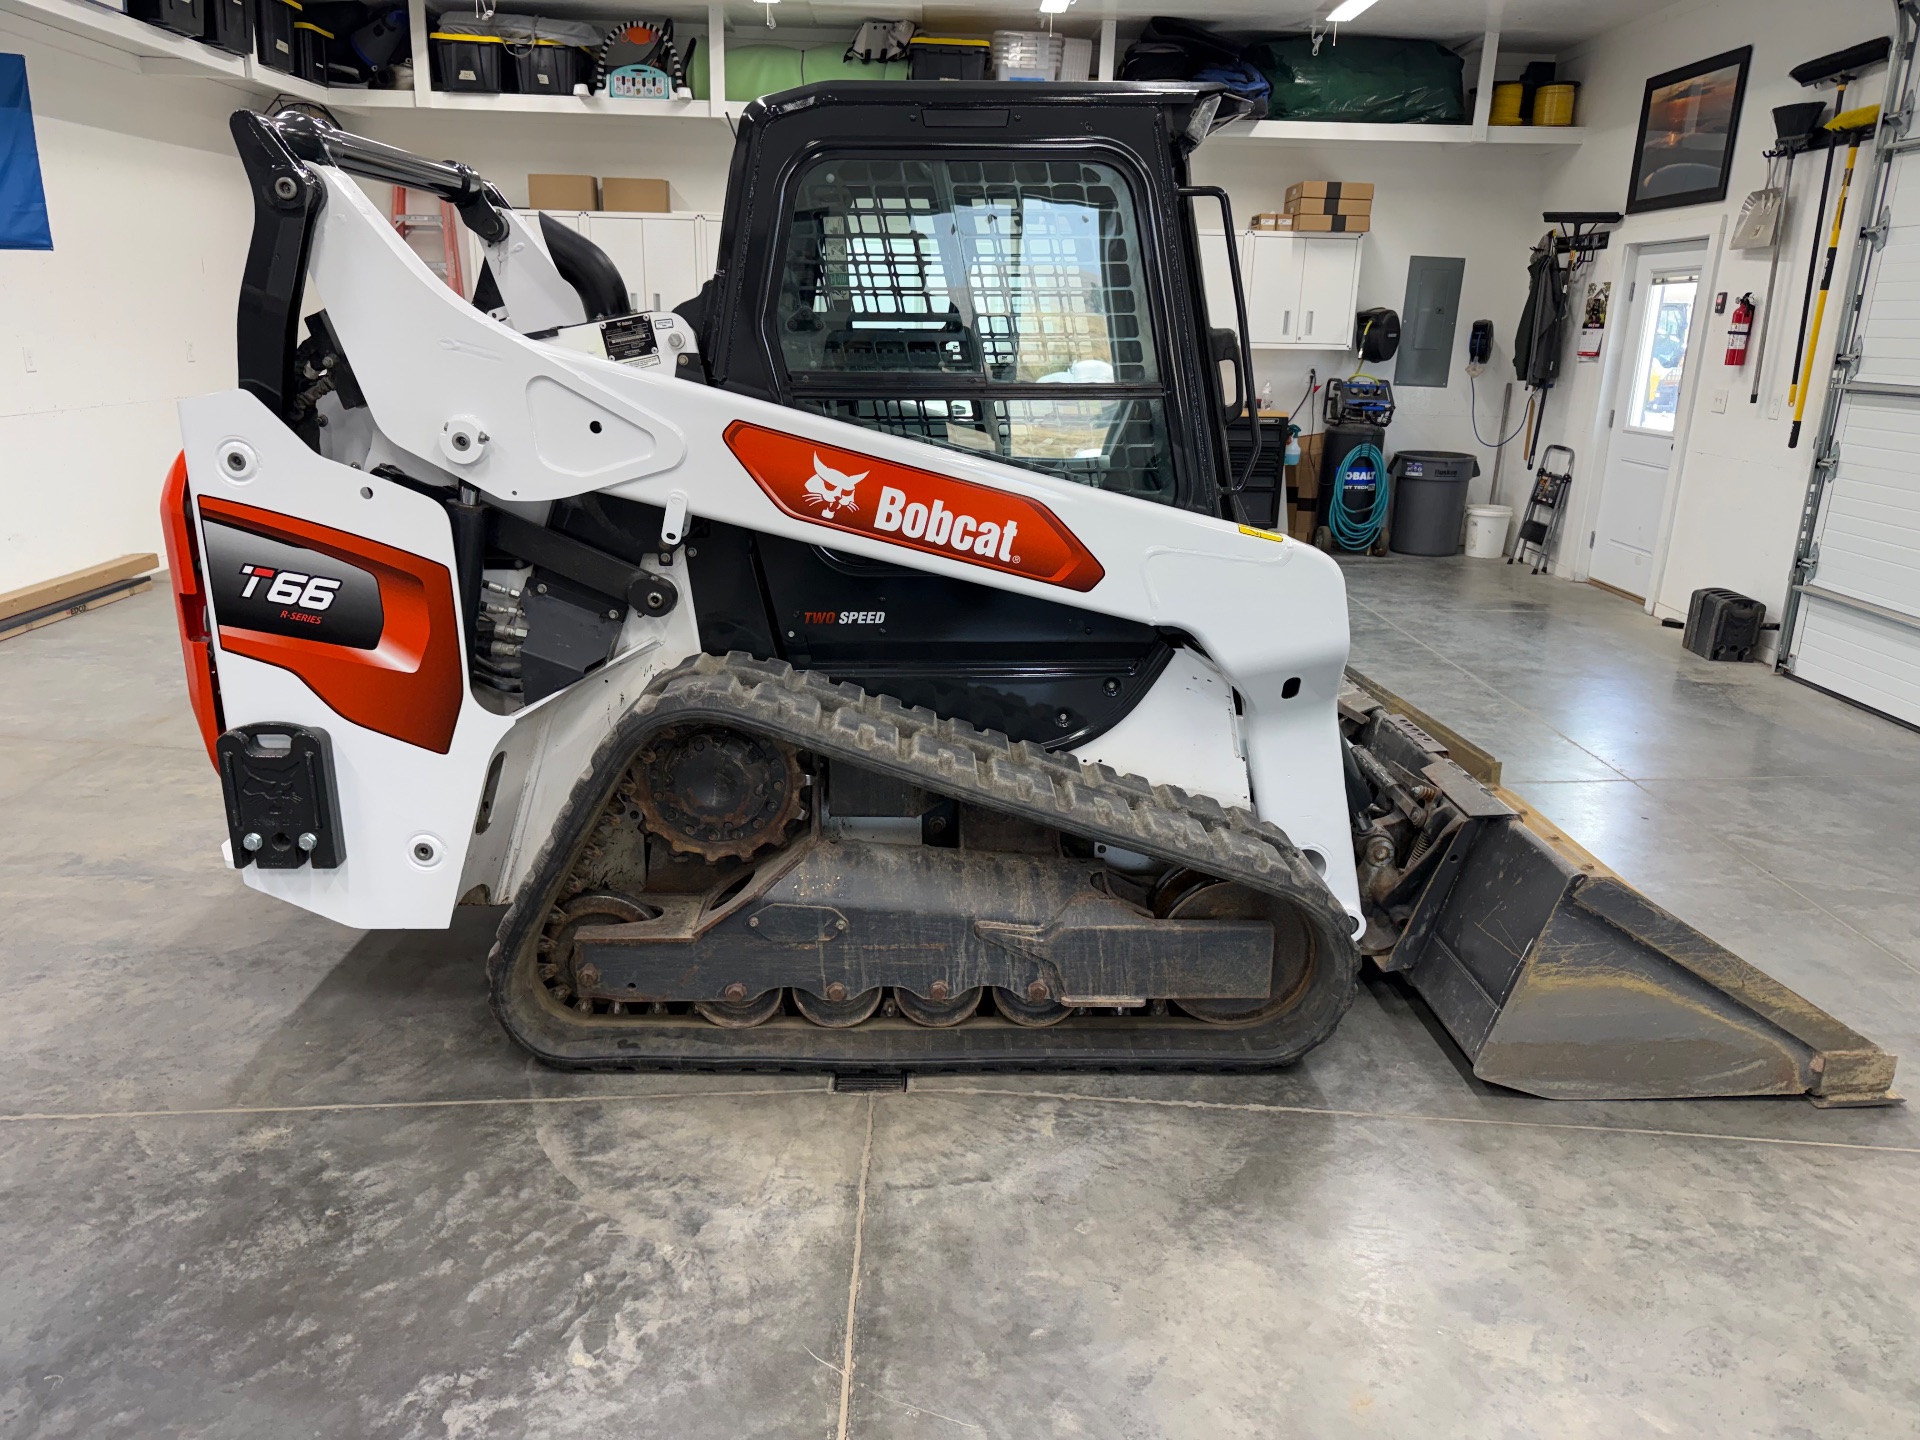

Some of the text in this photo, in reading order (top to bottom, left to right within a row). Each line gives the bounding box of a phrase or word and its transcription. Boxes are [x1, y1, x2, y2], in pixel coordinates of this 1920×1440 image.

[1344, 471, 1376, 481] OBALT
[873, 486, 1018, 562] Bobcat
[241, 564, 342, 611] T66
[280, 610, 323, 625] R-SERIES
[803, 611, 886, 625] TWO SPEED
